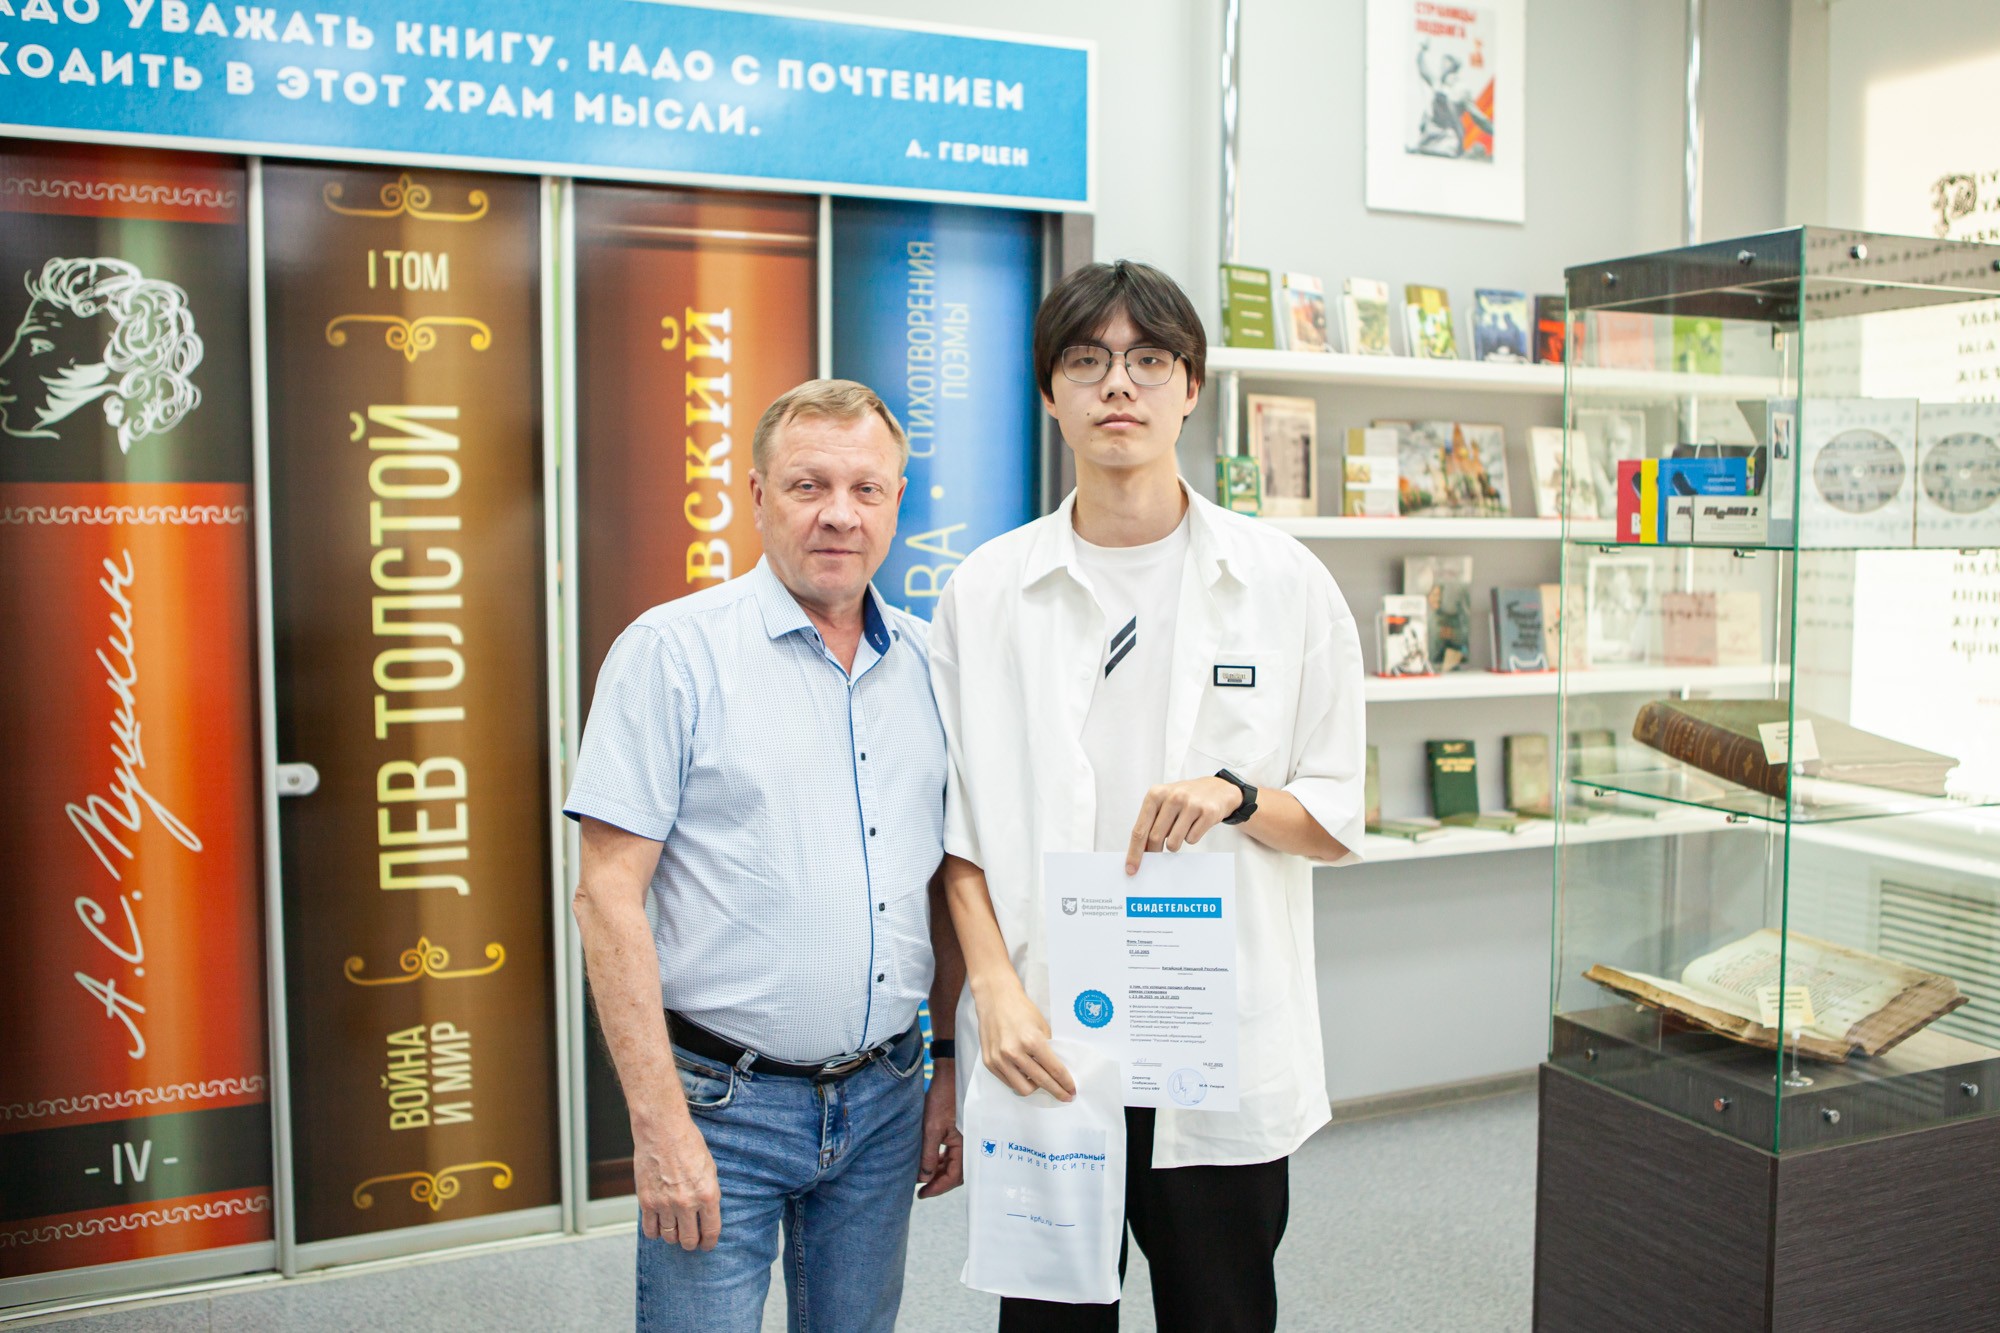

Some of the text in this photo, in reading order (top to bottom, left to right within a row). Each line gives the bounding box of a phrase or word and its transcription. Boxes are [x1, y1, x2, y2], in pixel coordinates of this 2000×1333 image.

[124, 0, 374, 49] УВАЖАТЬ
[395, 20, 568, 72] КНИГУ,
[587, 39, 714, 82] НАДО
[730, 54, 761, 86] С
[778, 60, 1024, 111] ПОЧТЕНИЕМ
[226, 60, 255, 96] В
[276, 66, 407, 109] ЭТОТ
[424, 77, 554, 121] ХРАМ
[574, 90, 762, 138] МЫСЛИ.
[905, 138, 1029, 167] А. ГЕРЦЕН
[383, 250, 450, 292] ТОМ
[907, 240, 936, 459] СТИХОТВОРЕНИЯ
[941, 302, 969, 400] ПОЭМЫ
[350, 404, 471, 896] ЛЕВ ТОЛСТОЙ
[65, 548, 203, 882] Пушкин
[1130, 902, 1217, 914] СВИДЕТЕЛЬСТВО
[379, 1024, 430, 1131] ВОЙНА
[429, 1020, 474, 1126] И МИР
[1008, 1142, 1106, 1162] Казанский федеральный
[1008, 1154, 1106, 1172] УНИВЕРСИТЕТ
[1030, 1214, 1053, 1226] kpfu.ru
